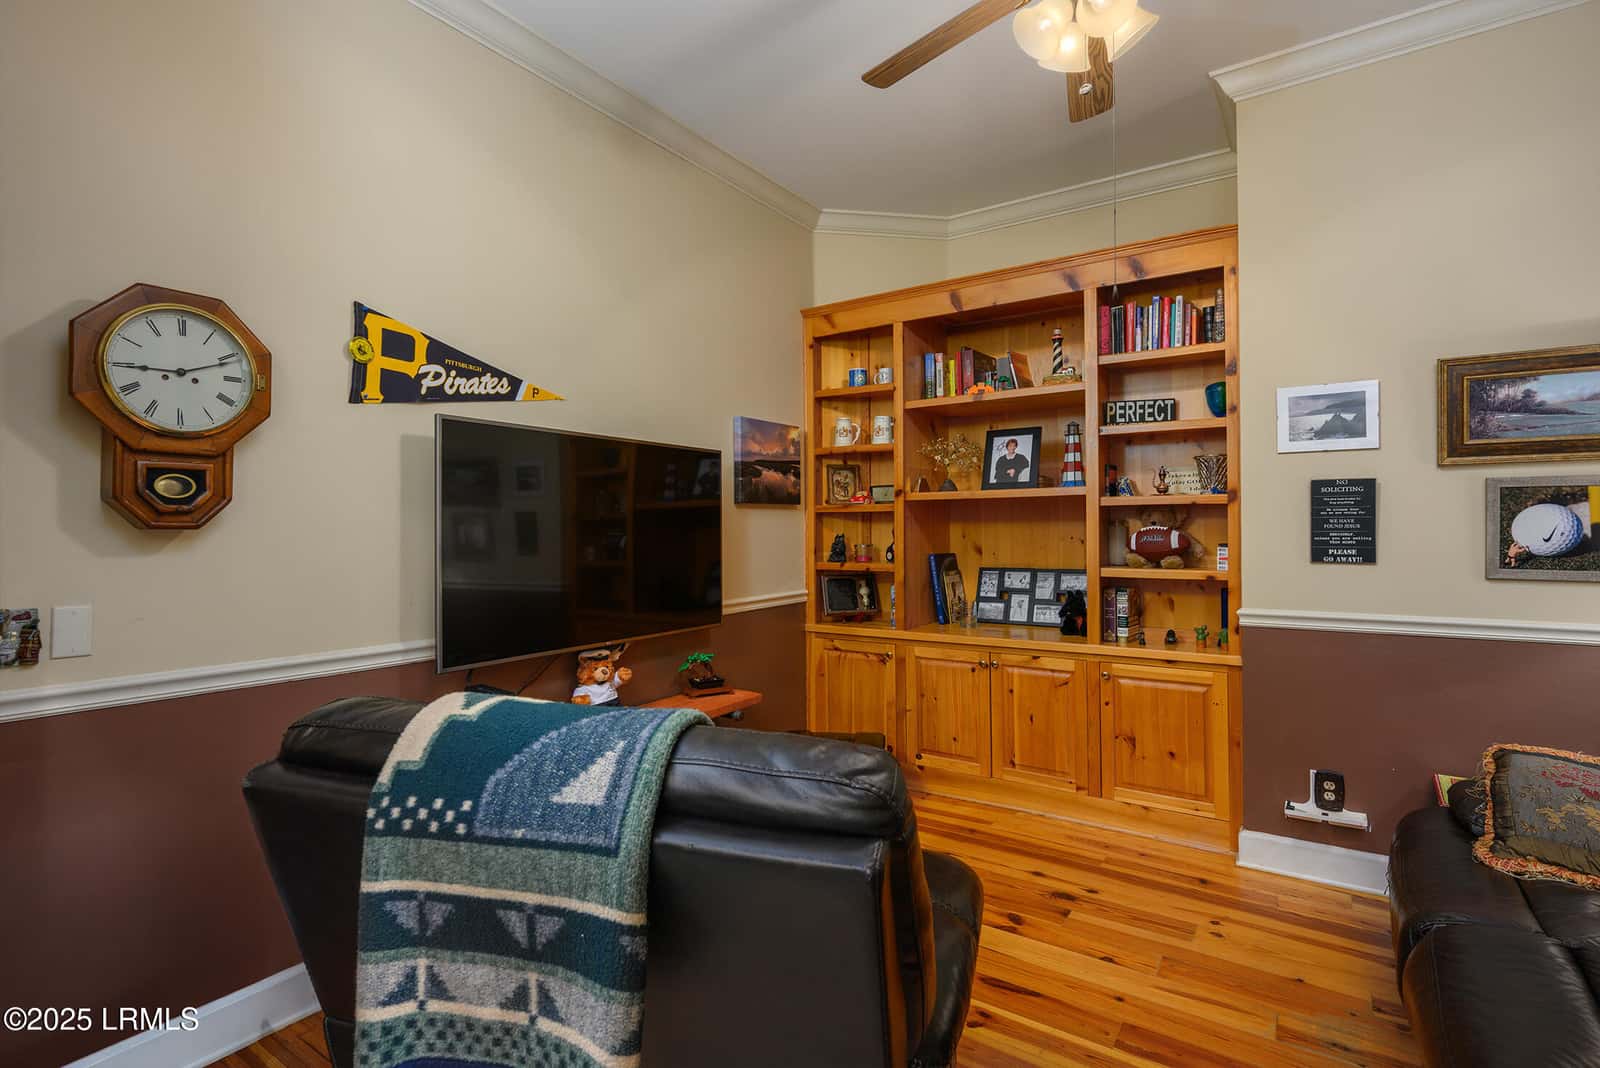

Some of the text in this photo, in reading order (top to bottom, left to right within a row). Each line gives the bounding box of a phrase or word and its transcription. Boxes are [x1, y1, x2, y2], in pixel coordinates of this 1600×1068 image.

[360, 312, 430, 404] P
[445, 358, 482, 373] PITTSBURGH
[418, 364, 511, 396] Pirates
[532, 387, 540, 399] P
[1106, 399, 1174, 424] PERFECT
